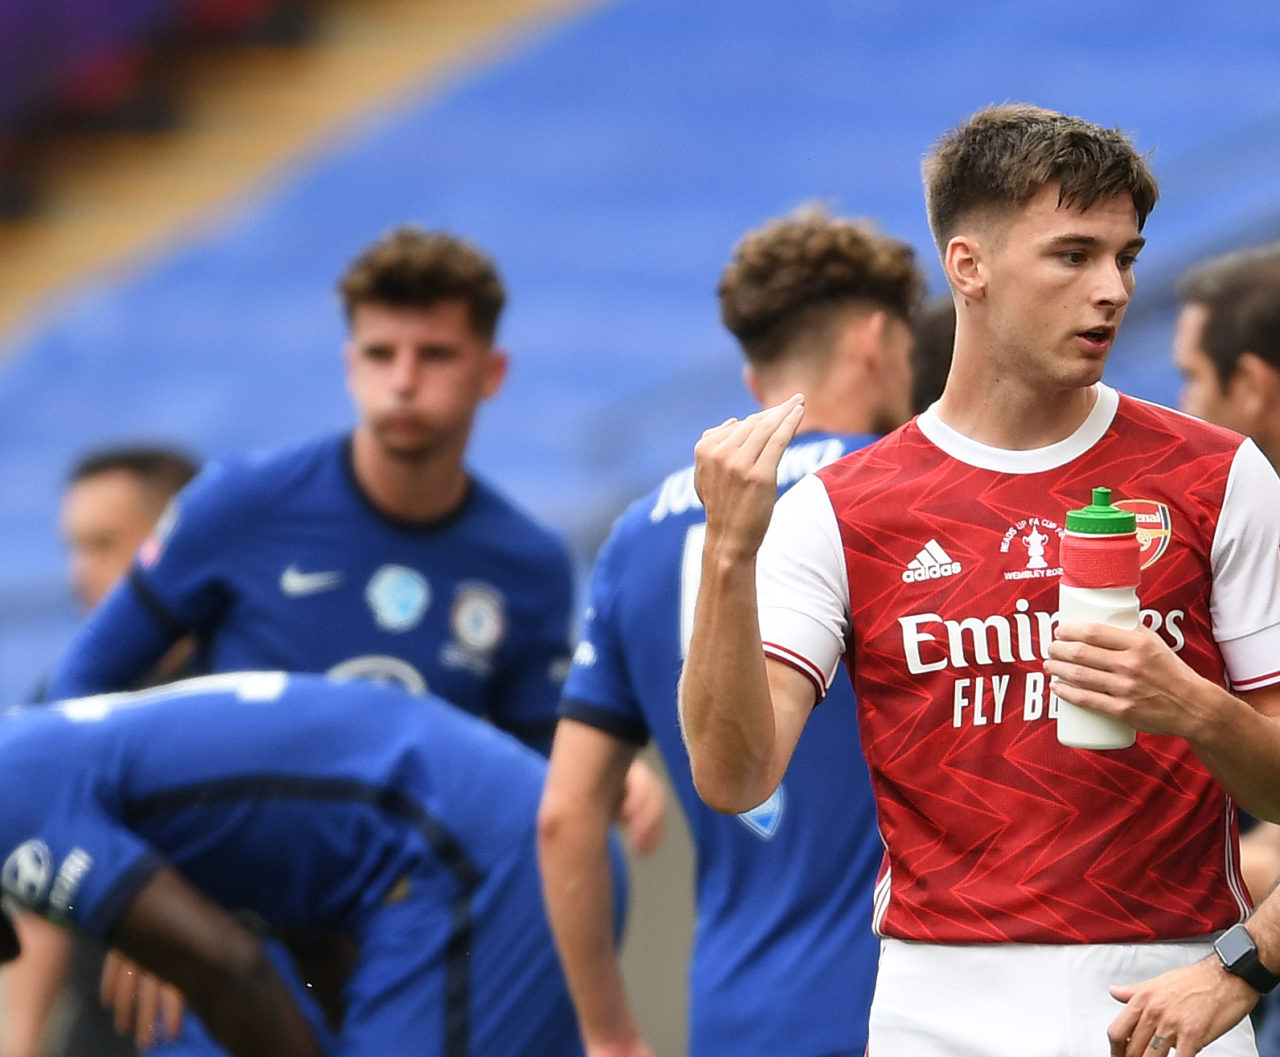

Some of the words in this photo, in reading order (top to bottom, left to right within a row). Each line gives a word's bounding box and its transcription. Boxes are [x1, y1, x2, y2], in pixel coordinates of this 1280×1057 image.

[902, 561, 962, 584] adidas
[1003, 569, 1045, 580] WEMBLEY
[1046, 567, 1064, 577] 202
[898, 598, 1185, 675] Emires
[953, 674, 1011, 728] FLY
